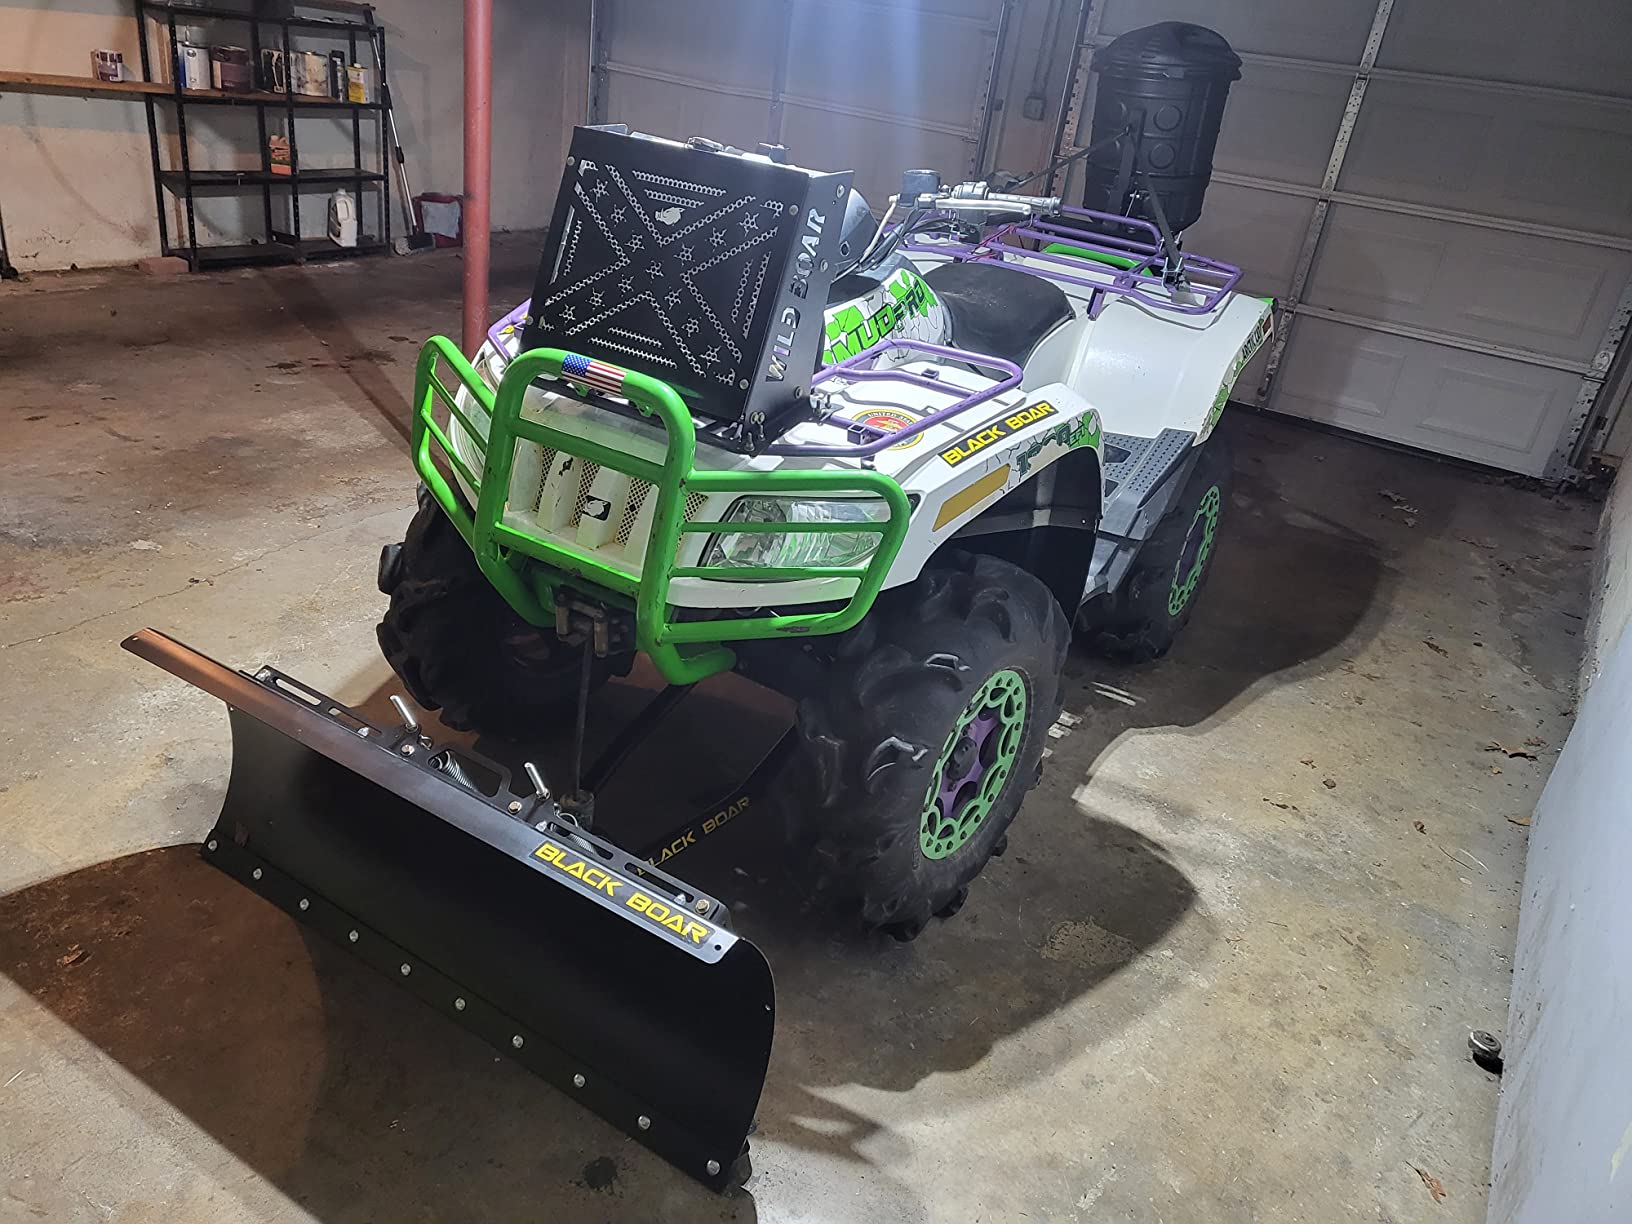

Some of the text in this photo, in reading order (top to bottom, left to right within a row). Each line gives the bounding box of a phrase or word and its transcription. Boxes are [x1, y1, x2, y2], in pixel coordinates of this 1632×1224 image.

[766, 208, 826, 382] WILD BOAR
[942, 404, 1055, 466] BLACK BOAR
[702, 796, 751, 835] BOAR
[535, 843, 711, 944] BLACK BOAR
